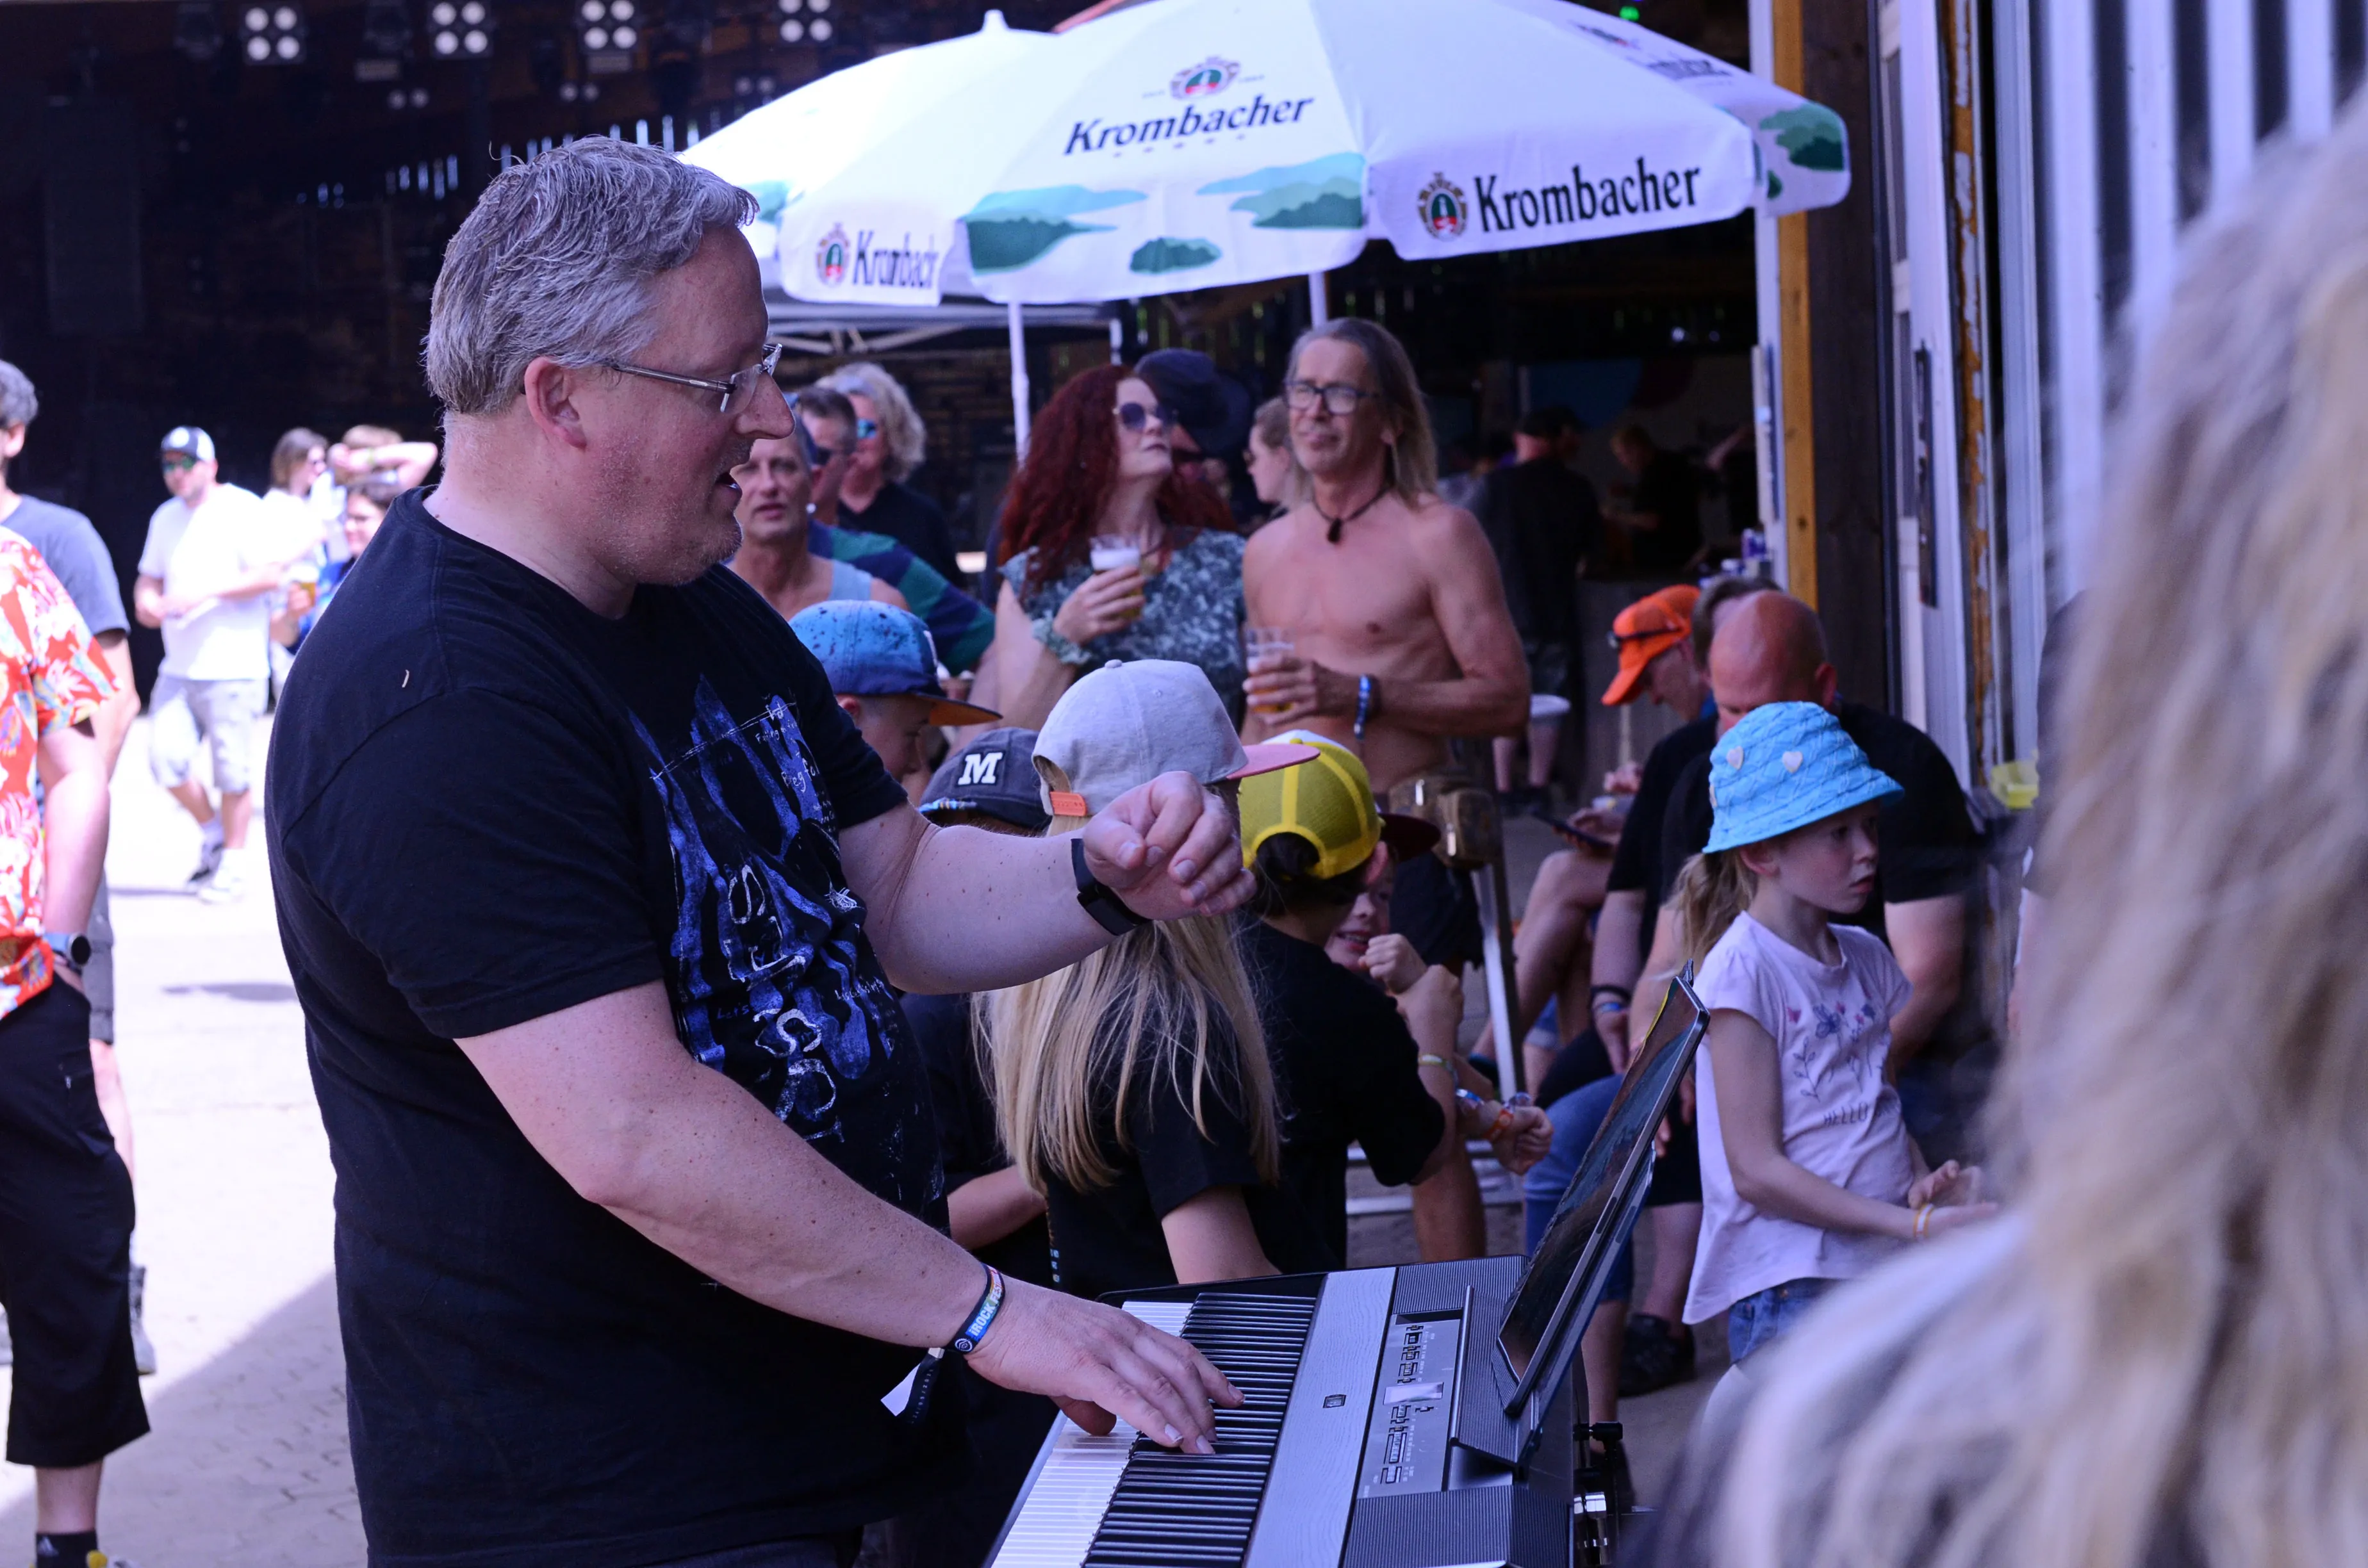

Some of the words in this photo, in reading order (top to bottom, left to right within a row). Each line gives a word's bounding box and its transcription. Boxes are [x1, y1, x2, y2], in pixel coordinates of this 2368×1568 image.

[1063, 92, 1315, 156] Krombacher
[1474, 156, 1701, 233] Krombacher
[958, 752, 1003, 785] M
[968, 1302, 996, 1336] iROCK
